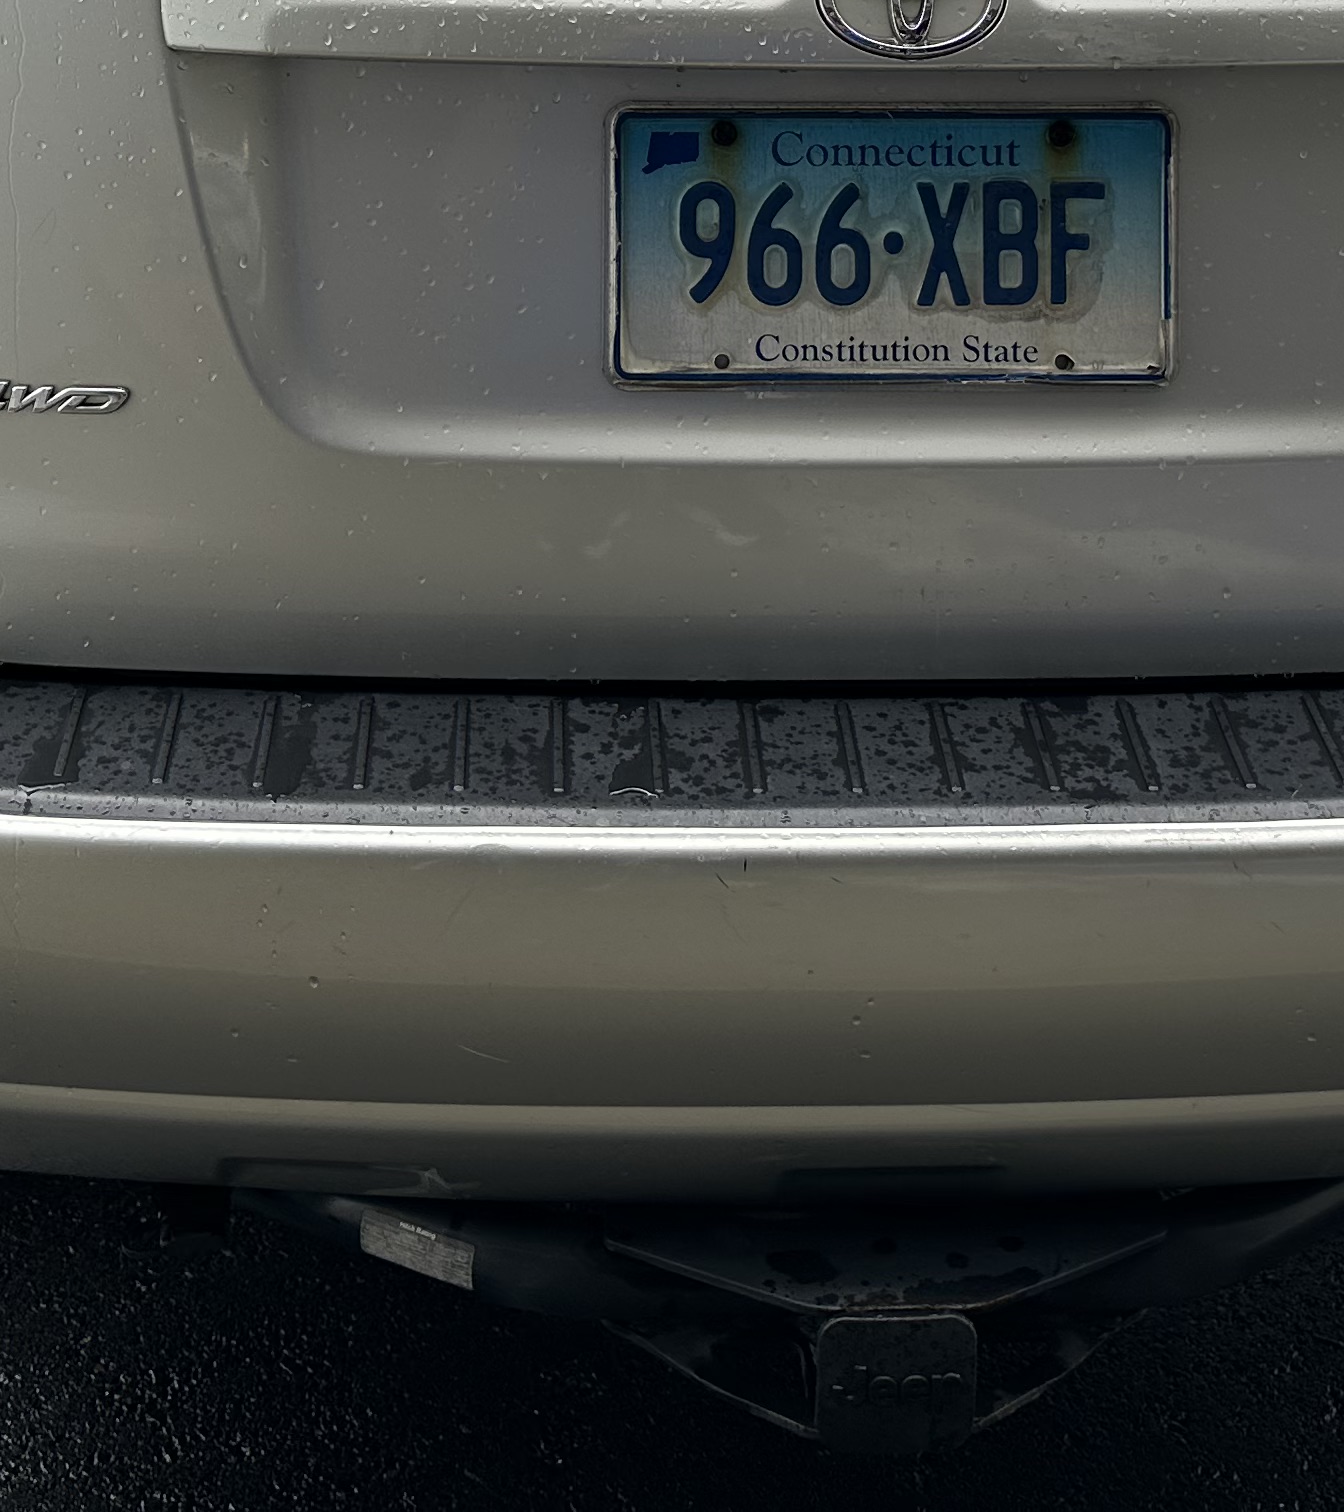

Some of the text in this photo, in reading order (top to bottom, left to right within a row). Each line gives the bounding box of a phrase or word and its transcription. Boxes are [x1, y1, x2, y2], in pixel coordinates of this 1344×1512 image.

[771, 130, 1021, 168] Connecticut
[755, 333, 1040, 365] Constitution State
